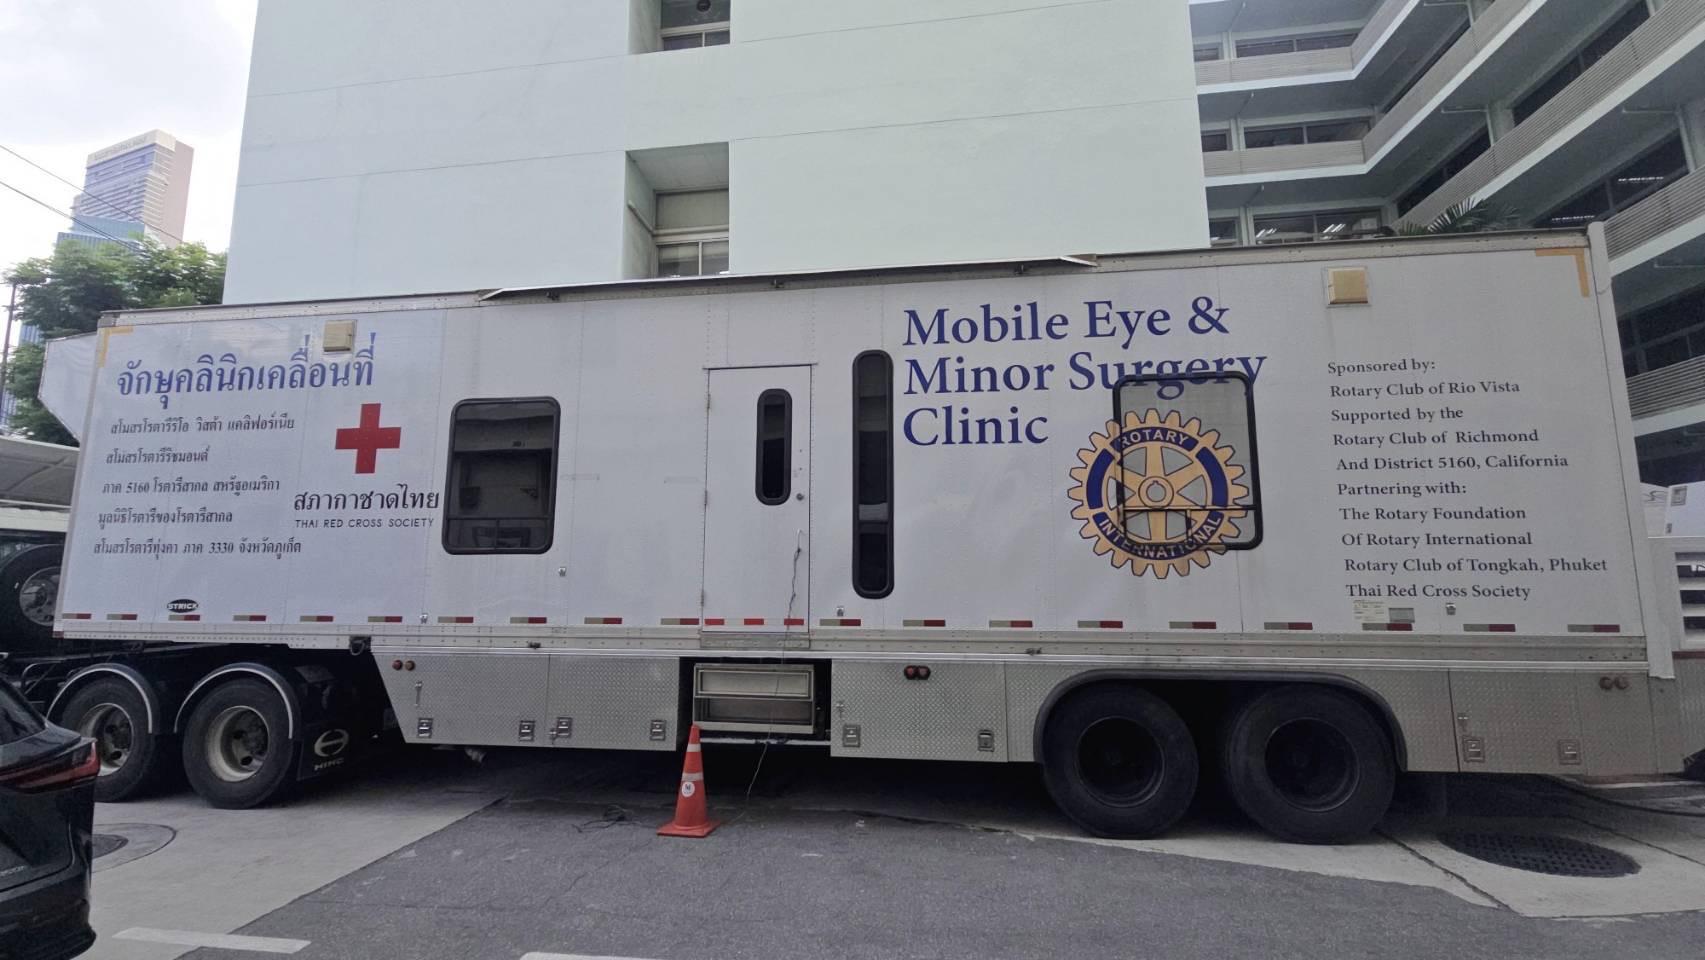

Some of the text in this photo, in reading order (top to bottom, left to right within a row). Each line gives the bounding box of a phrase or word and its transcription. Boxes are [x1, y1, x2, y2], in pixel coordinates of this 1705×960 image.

[902, 296, 1230, 350] Mobile Eye &
[117, 332, 377, 410] จักษุคลินิกเคลื่อนที่
[903, 351, 1267, 400] Minor Surgery
[1328, 358, 1436, 376] Sponsored by:
[1330, 381, 1521, 399] Rotary Club of Rio Vista
[1331, 406, 1464, 424] Supported by the
[903, 404, 1049, 446] Clinic
[1119, 429, 1189, 450] ROTARY
[1333, 429, 1540, 448] Rotary Club of Richmond
[1336, 454, 1569, 471] And District 5160, California
[125, 482, 150, 494] 5160
[293, 483, 440, 511] สภากาชาดไทย
[1337, 482, 1467, 498] Partnering with:
[295, 518, 435, 528] THAI RED CROSS SOCIETY
[1339, 506, 1526, 523] The Rotary Foundation
[1099, 517, 1221, 558] INTERNATIONAL
[1341, 532, 1533, 549] Of Rotary International
[208, 541, 234, 555] 3330
[1344, 557, 1608, 575] Rotary Club of Tongkah, Phuket
[1346, 584, 1531, 600] Thai Red Cross Society
